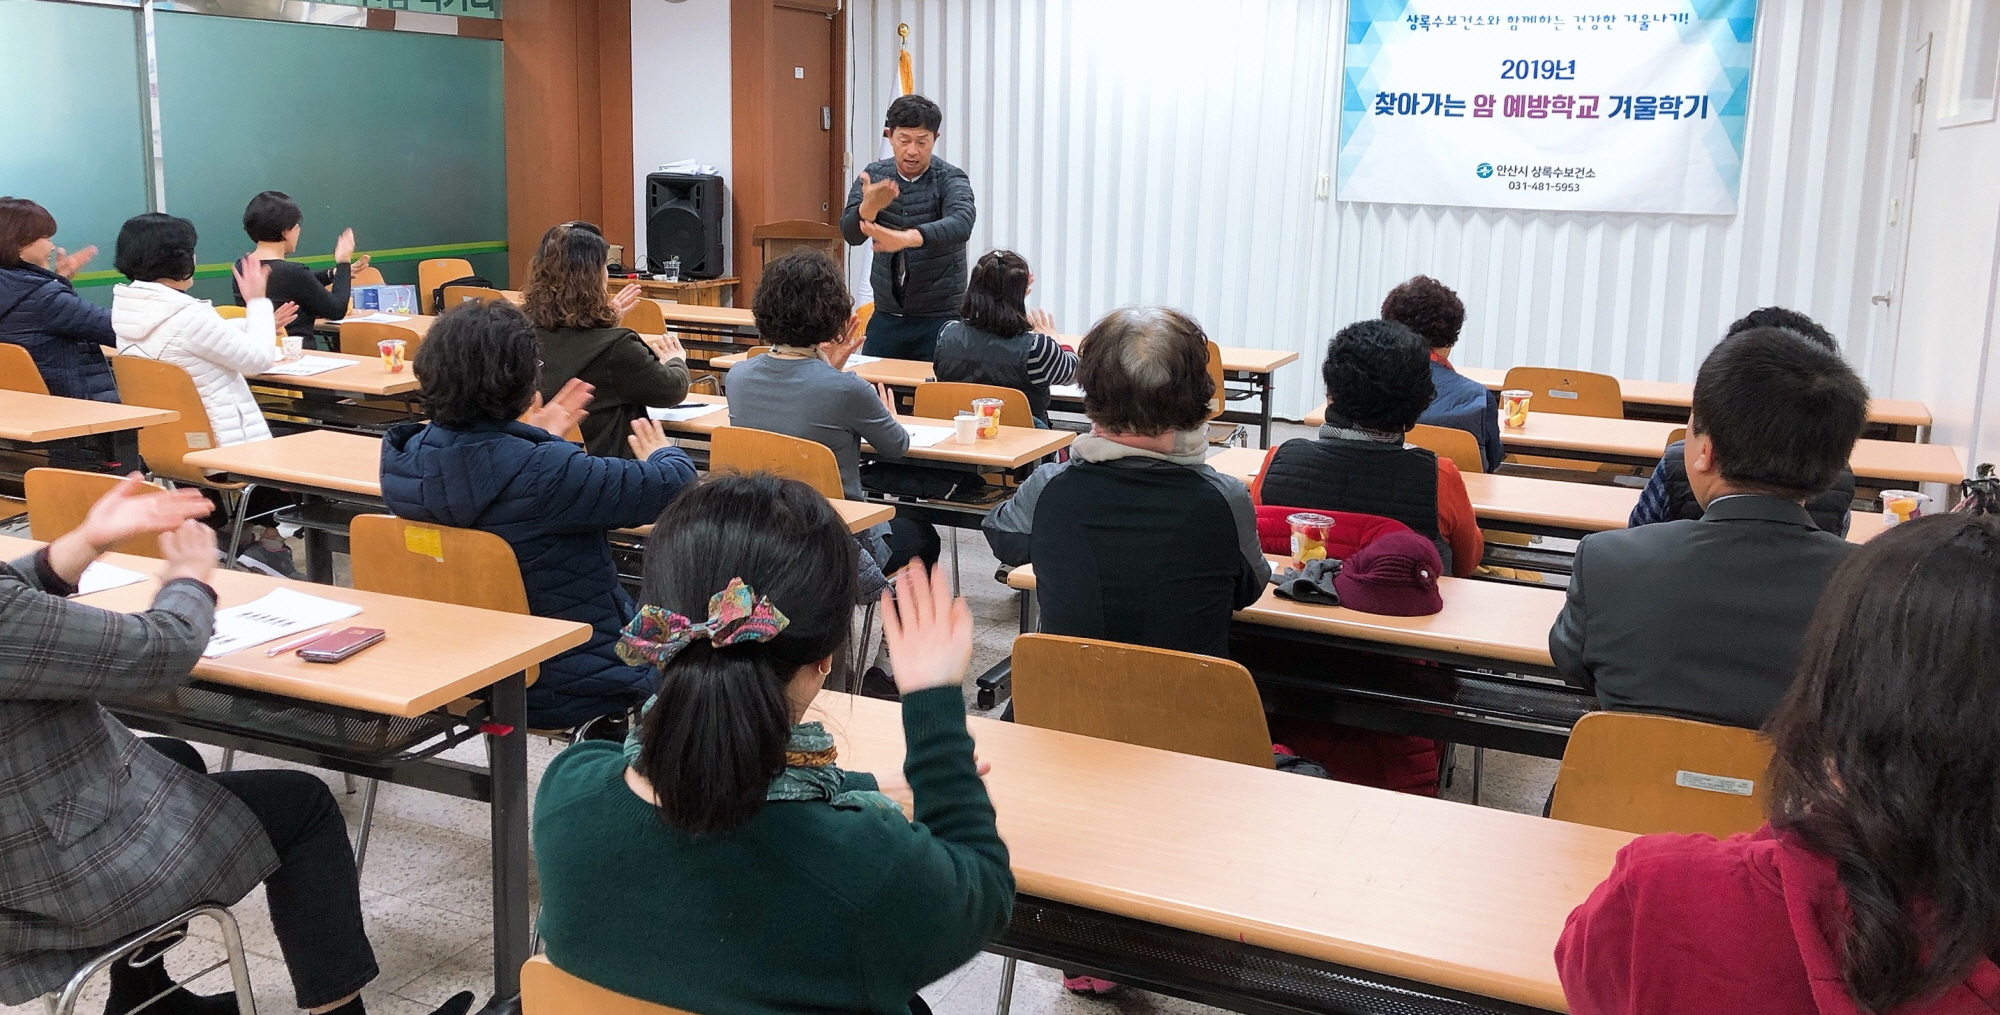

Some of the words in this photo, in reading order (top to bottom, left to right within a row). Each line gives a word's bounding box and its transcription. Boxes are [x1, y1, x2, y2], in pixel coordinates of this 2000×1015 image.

[1406, 14, 1501, 32] 상록수보건소와
[1507, 15, 1566, 32] 함께하는
[1573, 14, 1617, 31] 건강한
[1624, 12, 1689, 32] 겨울나기!
[1500, 59, 1576, 80] 2019년
[1375, 91, 1467, 118] 찾아가는
[1473, 94, 1497, 118] 암
[1503, 94, 1600, 120] 예방학교
[1608, 94, 1709, 121] 겨울학기
[1496, 164, 1529, 178] 안산시
[1531, 165, 1596, 180] 상록수보건소
[1508, 180, 1580, 193] 031-481-5953
